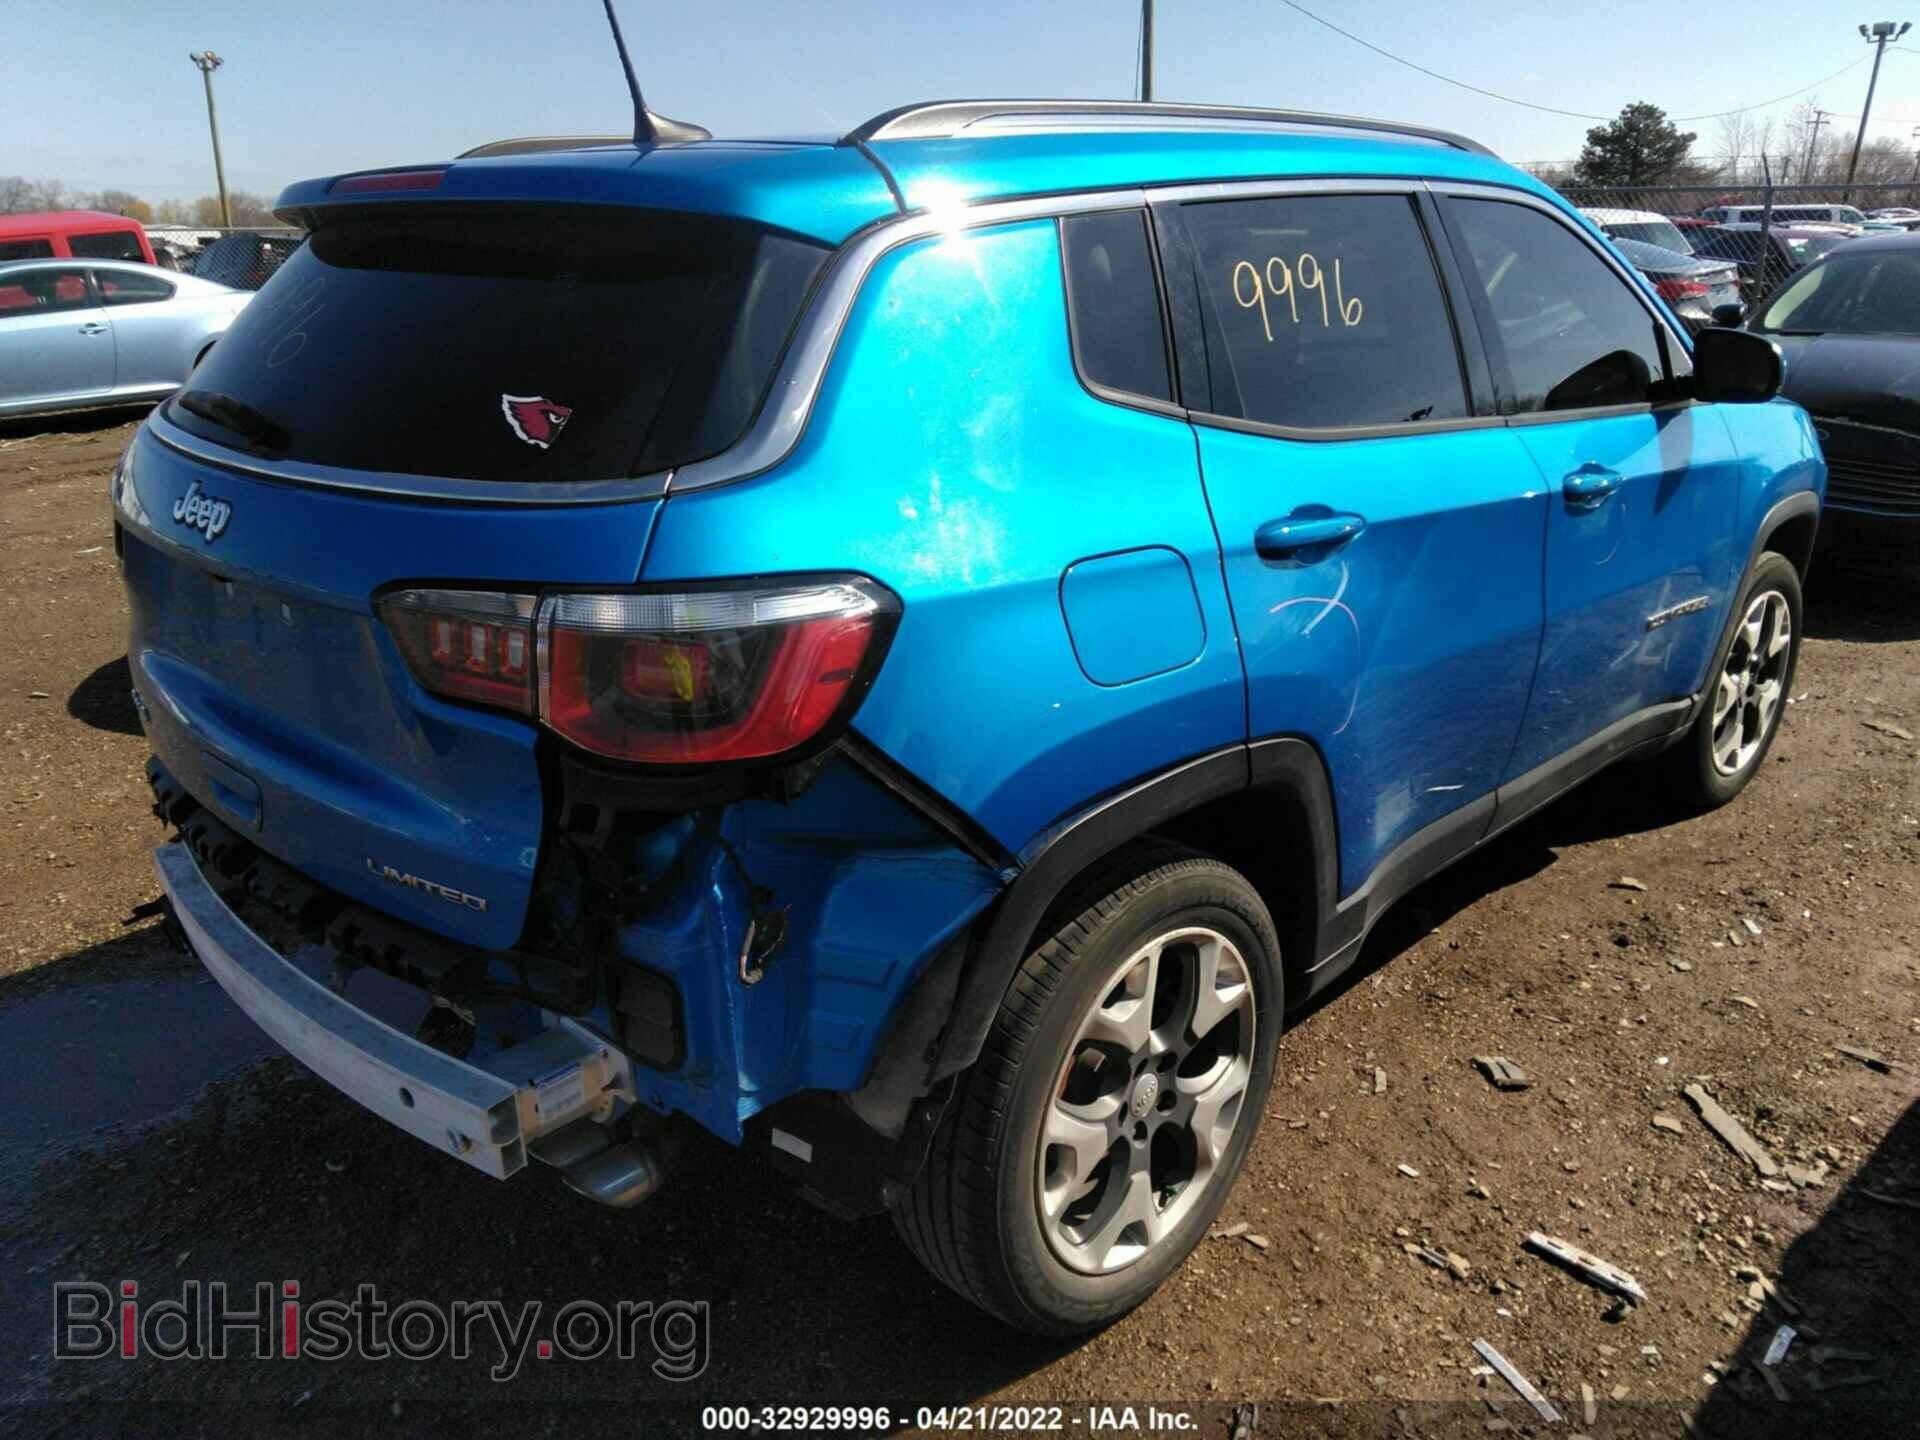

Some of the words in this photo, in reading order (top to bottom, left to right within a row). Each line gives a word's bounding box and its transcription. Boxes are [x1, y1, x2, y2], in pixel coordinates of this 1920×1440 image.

[1233, 253, 1363, 342] 9996
[172, 481, 231, 541] Jeep
[366, 857, 487, 912] LIMITED
